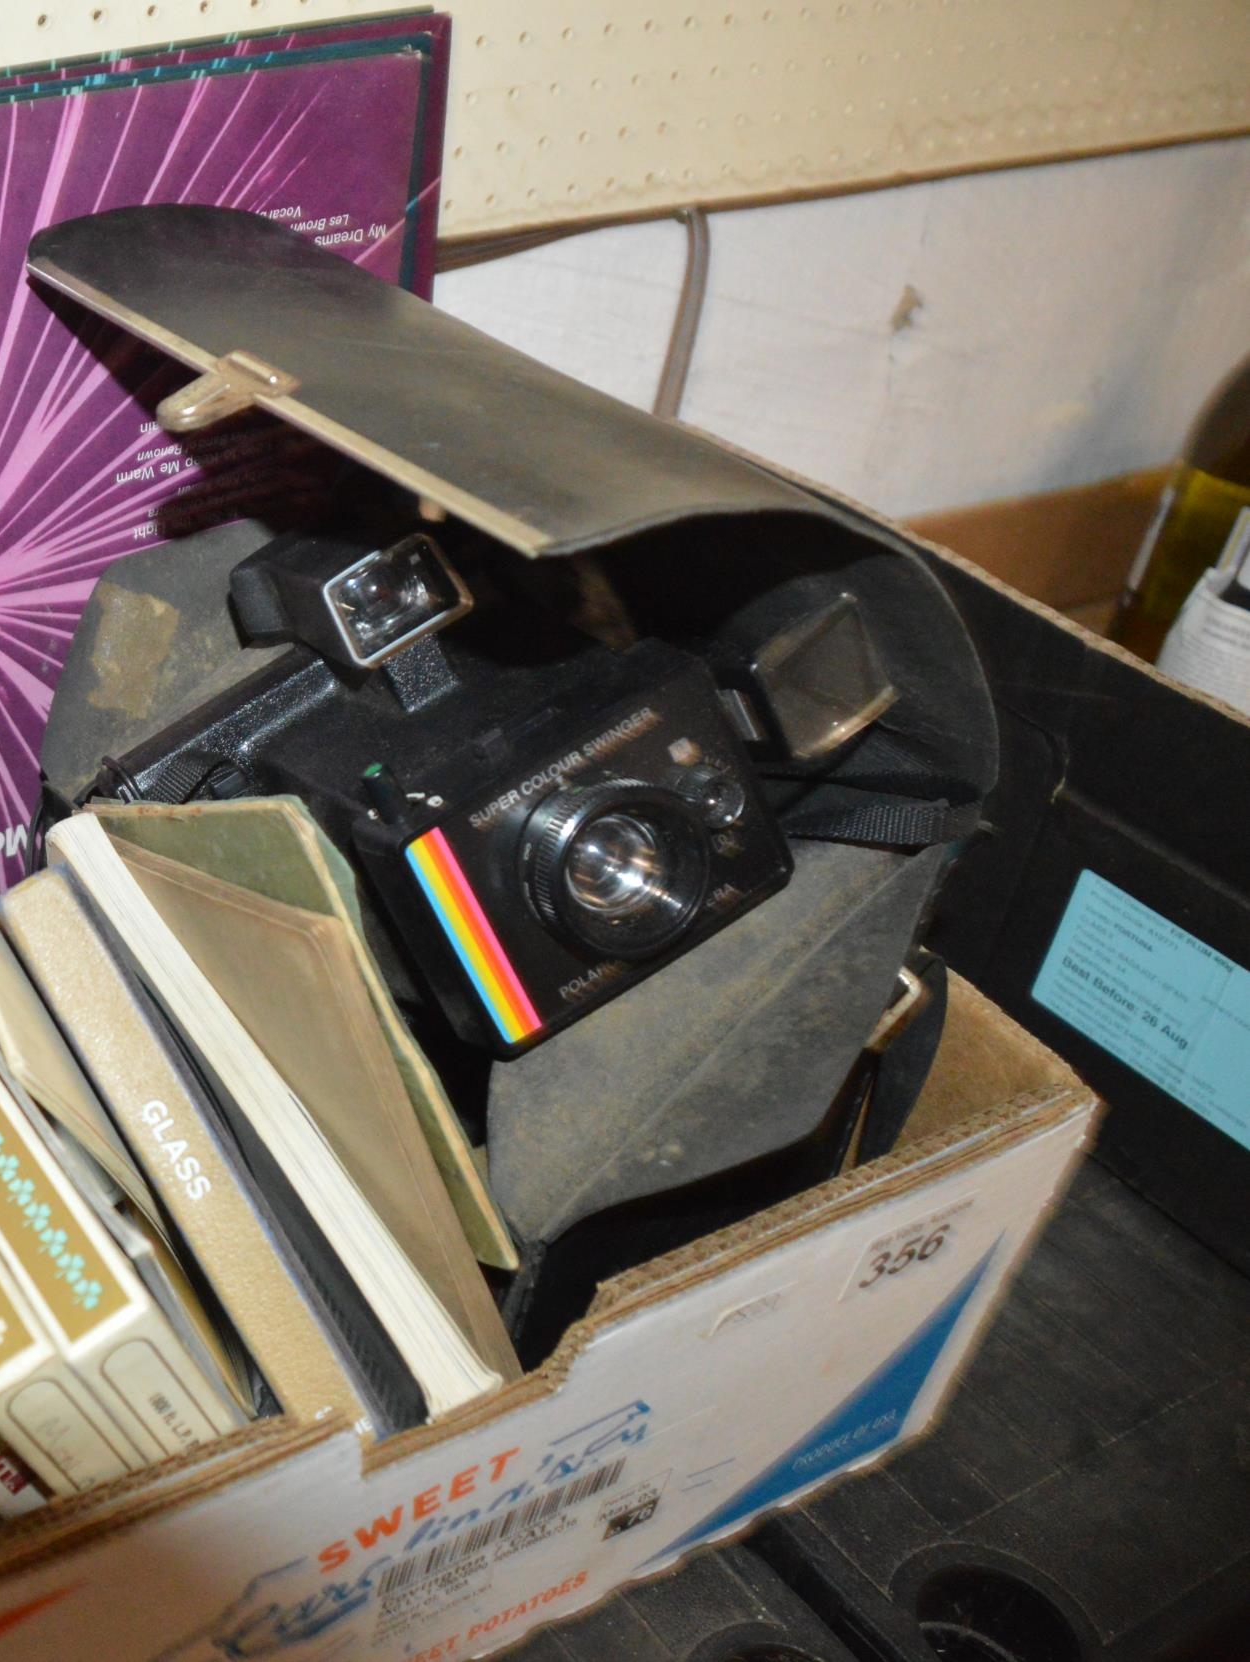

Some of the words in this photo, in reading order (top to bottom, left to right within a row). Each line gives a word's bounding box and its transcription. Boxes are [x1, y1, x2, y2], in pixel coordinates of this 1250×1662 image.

[269, 206, 301, 219] Vocal
[330, 214, 349, 225] Les
[314, 228, 363, 246] Dreams
[368, 223, 387, 239] My
[137, 443, 182, 461] Renown
[116, 467, 155, 483] Warm
[160, 460, 180, 474] Me
[469, 788, 520, 829] SUPER
[520, 752, 583, 797] COLOUR
[583, 707, 652, 757] SWINGER
[1060, 955, 1091, 981] Best
[1091, 976, 1141, 1015] Before:
[1159, 1022, 1190, 1050] Aug
[142, 1100, 211, 1200] GLASS
[859, 1224, 950, 1289] 356
[318, 1447, 520, 1575] SWEET
[467, 1570, 588, 1640] POTATOES
